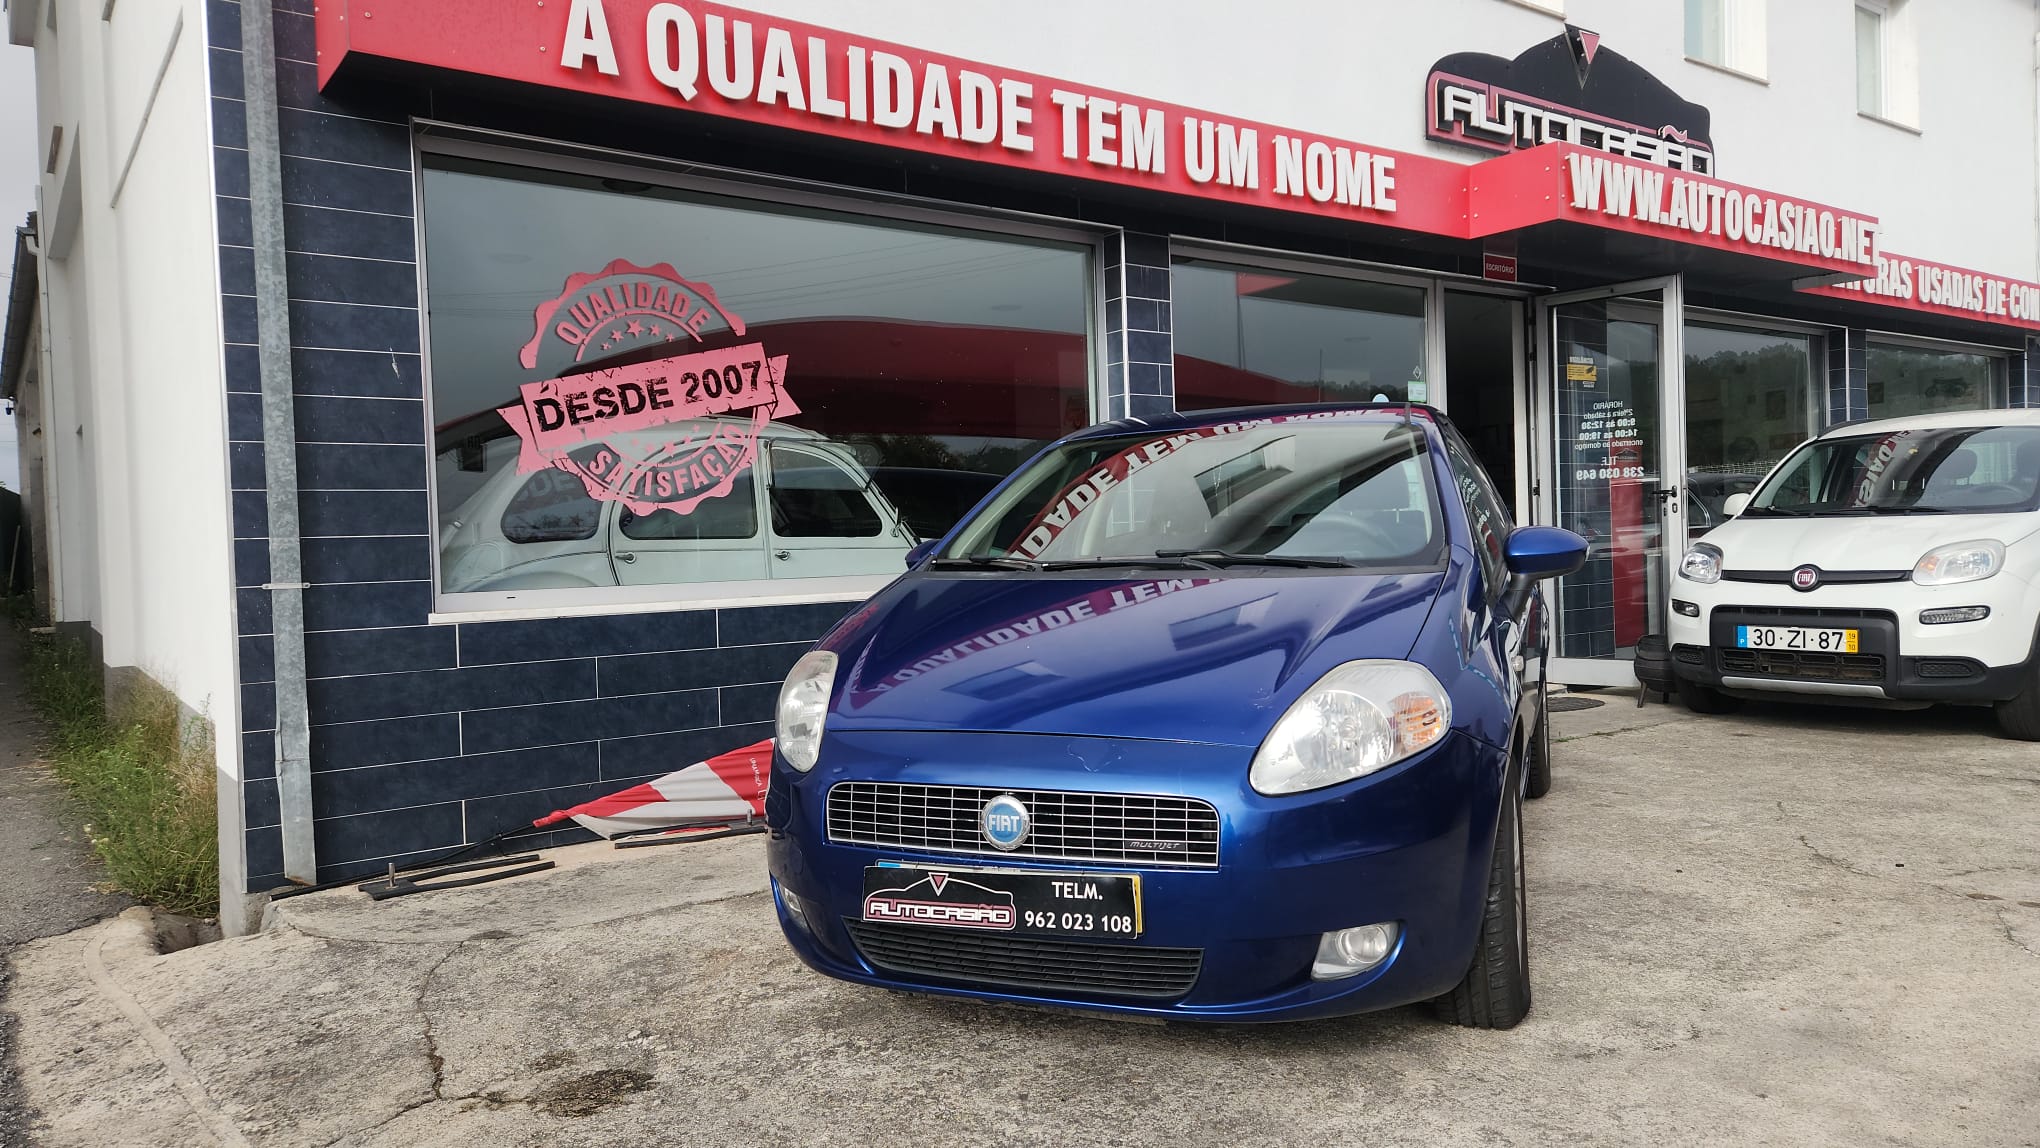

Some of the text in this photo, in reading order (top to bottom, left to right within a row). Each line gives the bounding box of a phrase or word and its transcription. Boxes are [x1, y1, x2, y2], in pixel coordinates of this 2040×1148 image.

[560, 0, 1397, 211] A QUALIDADE TEM UM NOME
[1485, 262, 1515, 274] ESCRITÓRIO
[1917, 265, 1984, 312] USADAS
[1986, 279, 2007, 315] DE
[555, 281, 712, 345] QUALIDADE
[532, 360, 762, 433] DESDE 2007
[1799, 573, 1812, 583] FIAT
[988, 814, 1020, 833] FIAT
[1052, 881, 1103, 900] TELM.
[1024, 910, 1132, 932] 962 023 108
